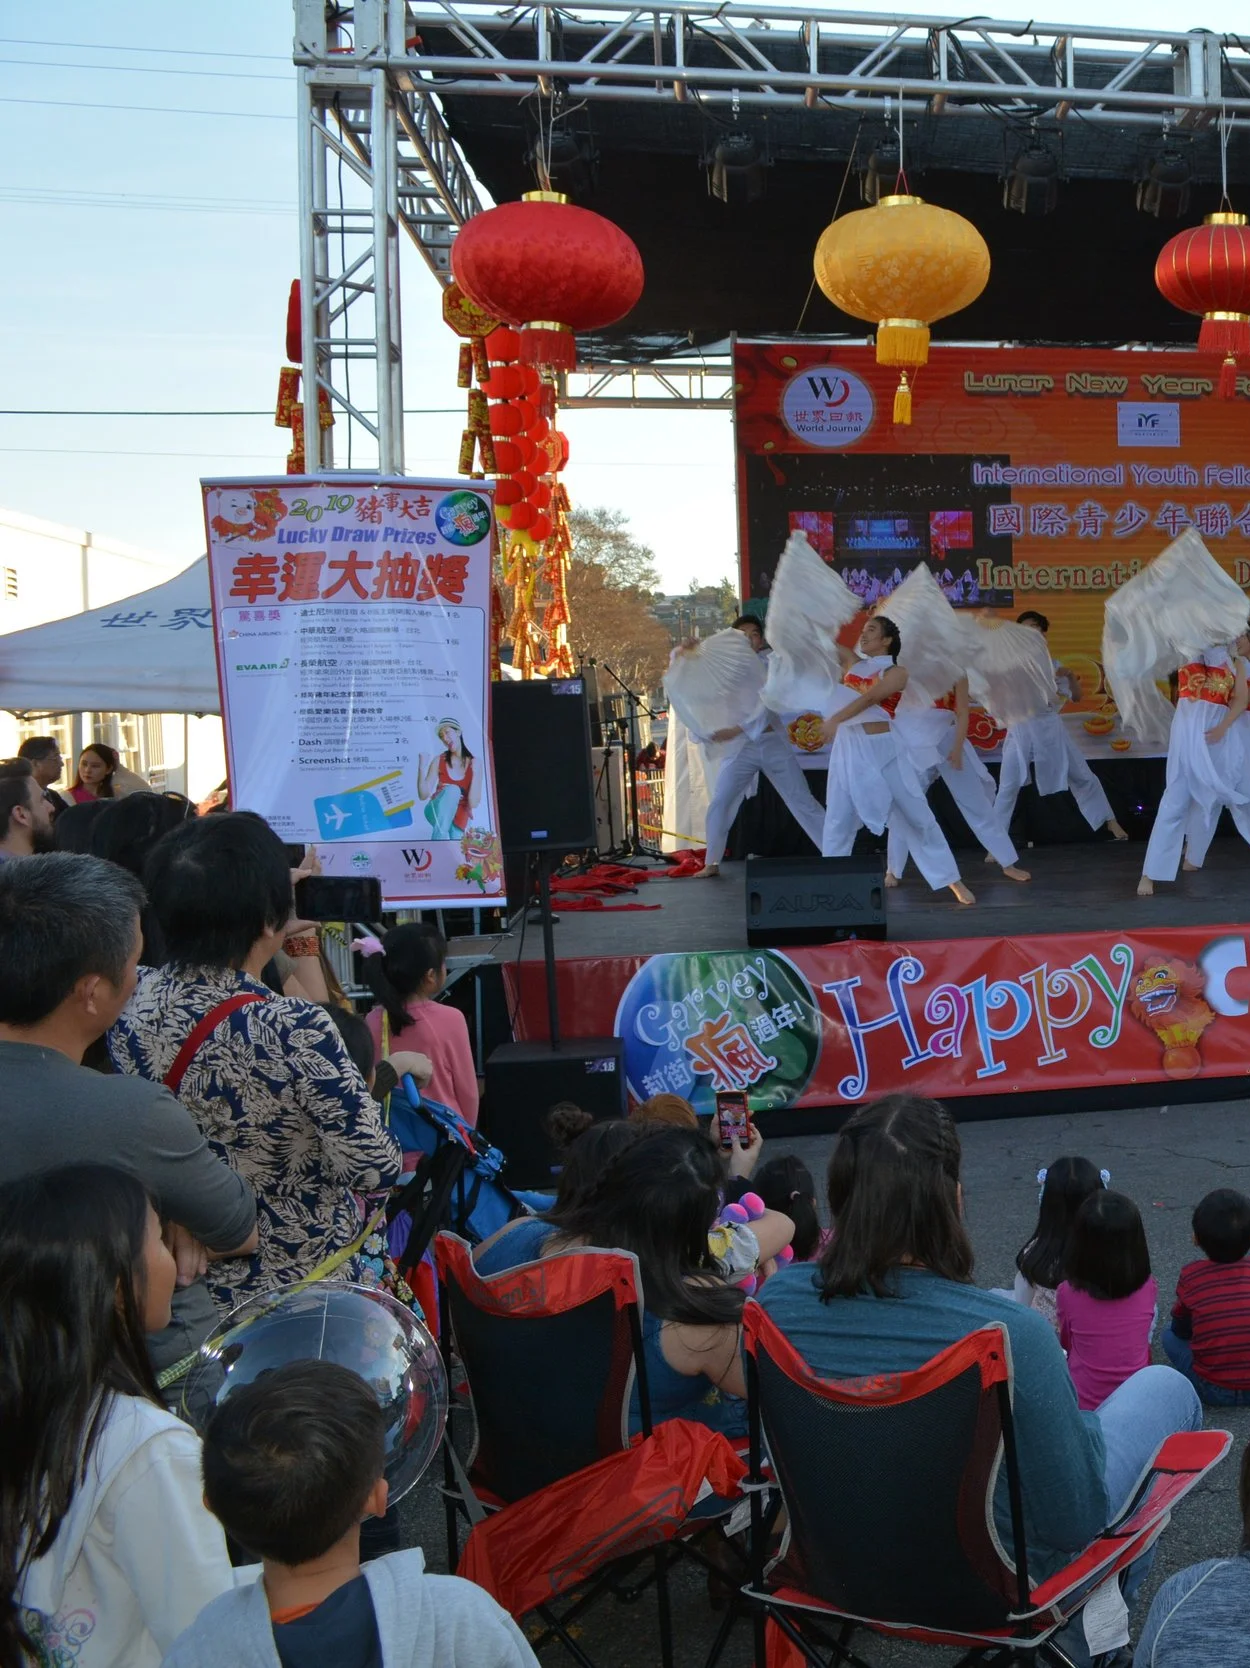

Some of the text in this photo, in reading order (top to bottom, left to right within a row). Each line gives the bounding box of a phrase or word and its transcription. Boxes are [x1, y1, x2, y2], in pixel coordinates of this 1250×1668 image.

[964, 371, 1055, 392] Lunar
[1065, 372, 1128, 394] New
[1141, 374, 1213, 394] Year
[793, 410, 864, 422] 世界日報
[796, 424, 861, 432] World Journal
[973, 463, 1124, 486] International
[1132, 464, 1198, 487] Youth
[289, 494, 354, 522] 2019
[355, 492, 433, 525] 豬事大吉
[277, 526, 436, 545] Lucky Draw Prizes
[230, 550, 470, 604] 幸運大抽獎
[299, 756, 351, 764] Screenshot
[768, 893, 864, 914] AURA
[636, 957, 768, 1051] Garvey
[822, 943, 1136, 1101] Happy
[682, 1010, 777, 1091] 瘋
